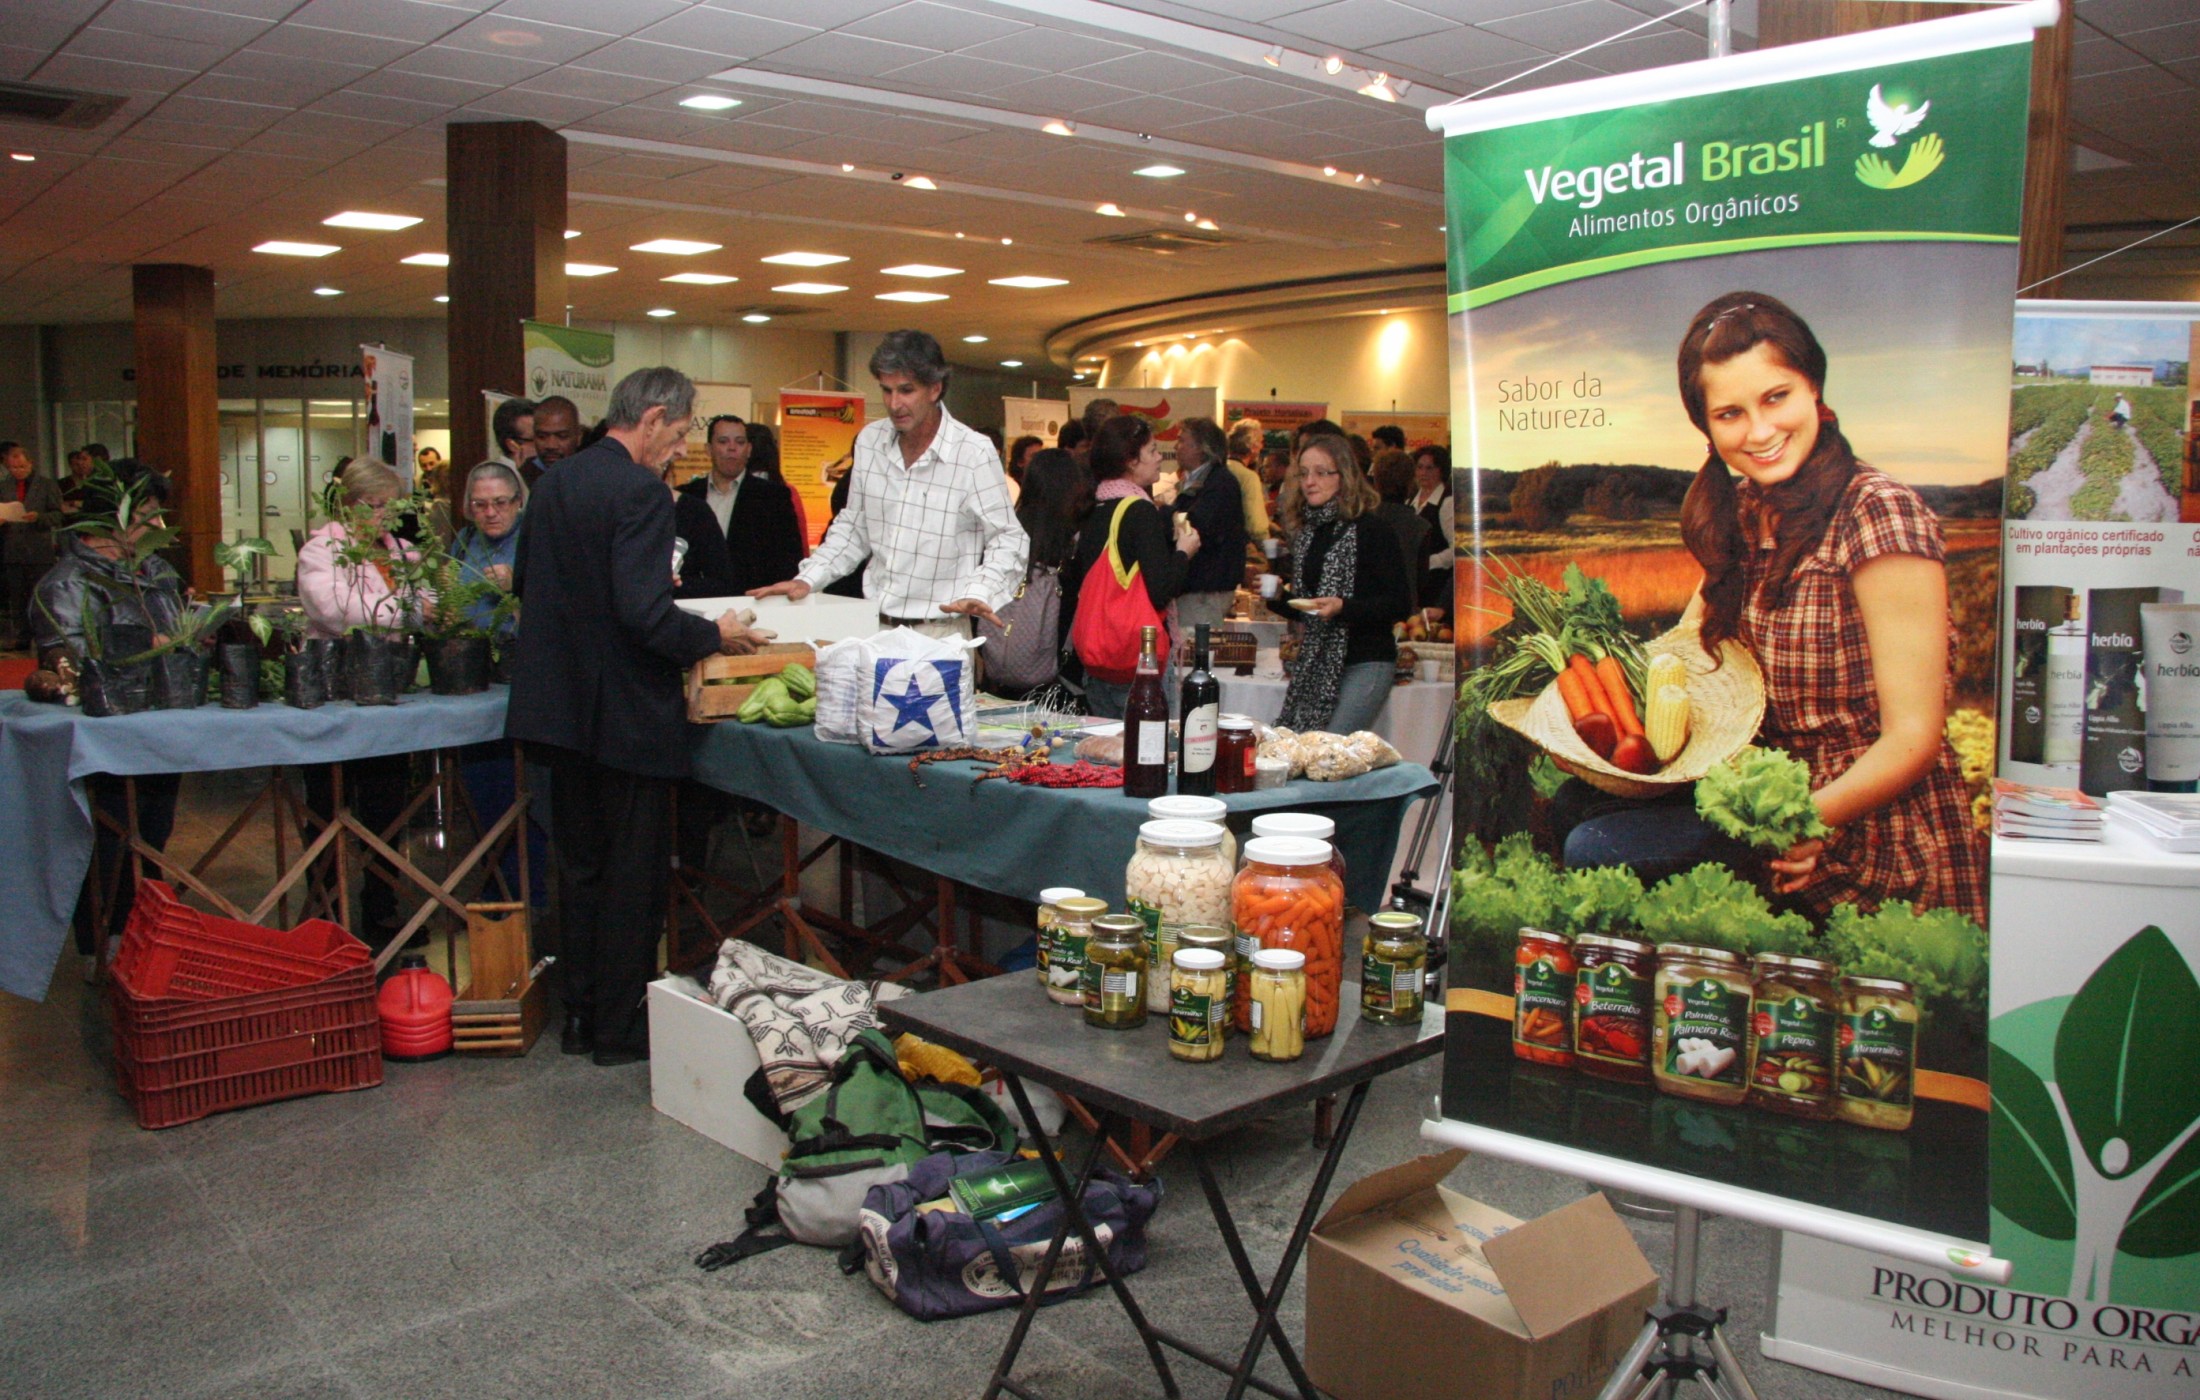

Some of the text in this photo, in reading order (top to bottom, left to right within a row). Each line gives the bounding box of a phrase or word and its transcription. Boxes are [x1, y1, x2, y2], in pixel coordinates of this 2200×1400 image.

[1525, 121, 1824, 209] Vegetal Brasil
[1569, 192, 1799, 238] Alimentos Orgânicos
[217, 360, 365, 379] DE MEMÓRIA
[1498, 371, 1601, 403] Sabor da
[1498, 405, 1613, 432] Natureza.
[2009, 527, 2164, 543] Cultivo orgânico certificado
[2016, 543, 2152, 557] em plantações próprias
[1591, 1000, 1641, 1015] Beterraba
[1684, 1010, 1731, 1024] Palmito de
[1673, 1024, 1718, 1036] Palmeira
[1781, 1035, 1816, 1047] Pepino
[1853, 1043, 1904, 1057] Minimilho
[1871, 1266, 2079, 1331] PRODUTO
[1890, 1310, 2193, 1377] MELHOR PARA A
